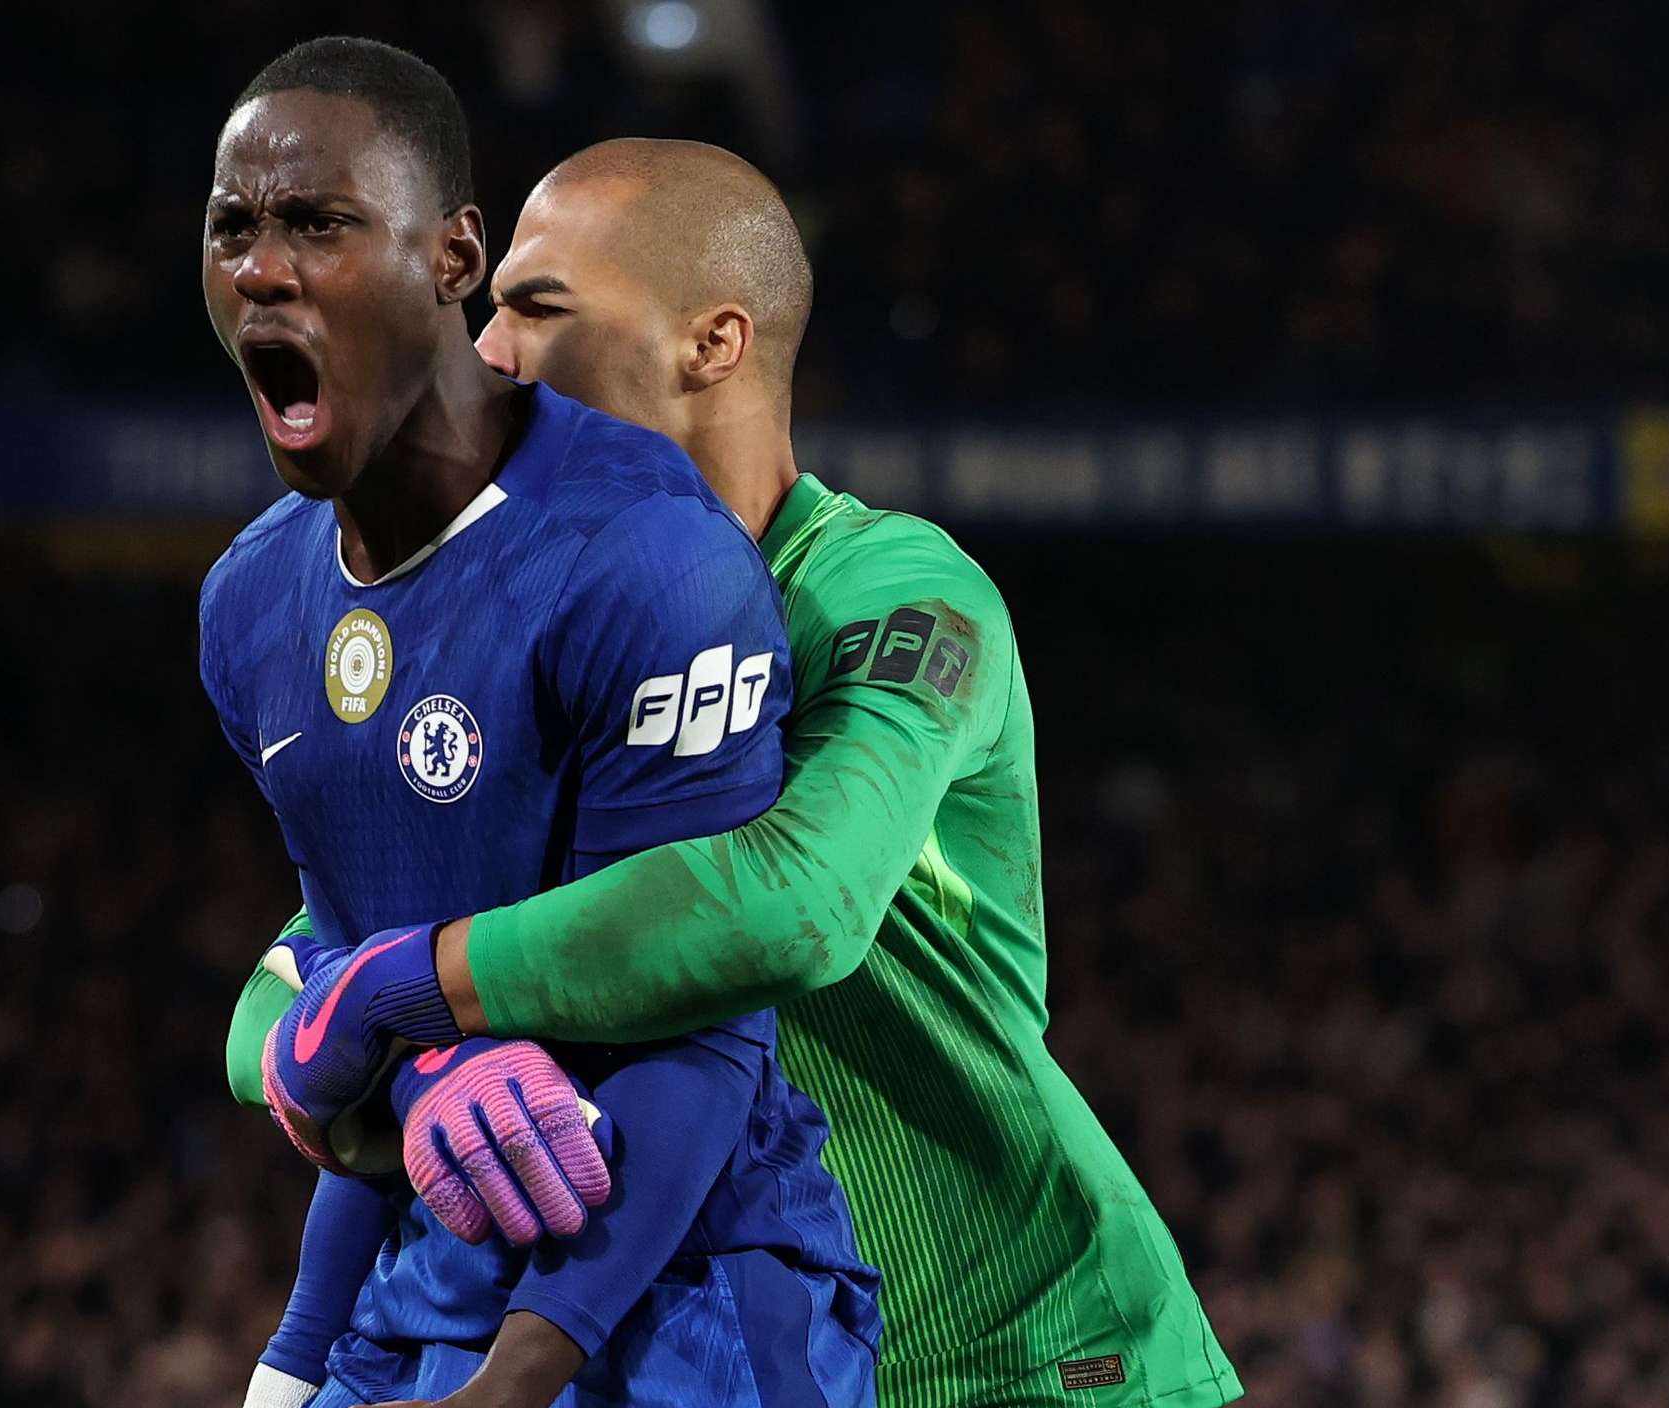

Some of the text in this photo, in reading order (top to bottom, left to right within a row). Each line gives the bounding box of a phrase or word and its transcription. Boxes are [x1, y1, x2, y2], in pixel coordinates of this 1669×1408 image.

[329, 619, 386, 680] WORLD CHAMPIONS
[341, 696, 367, 713] FIFA
[413, 699, 465, 723] CHELSEA
[412, 777, 467, 798] FOOTBALL CLUB
